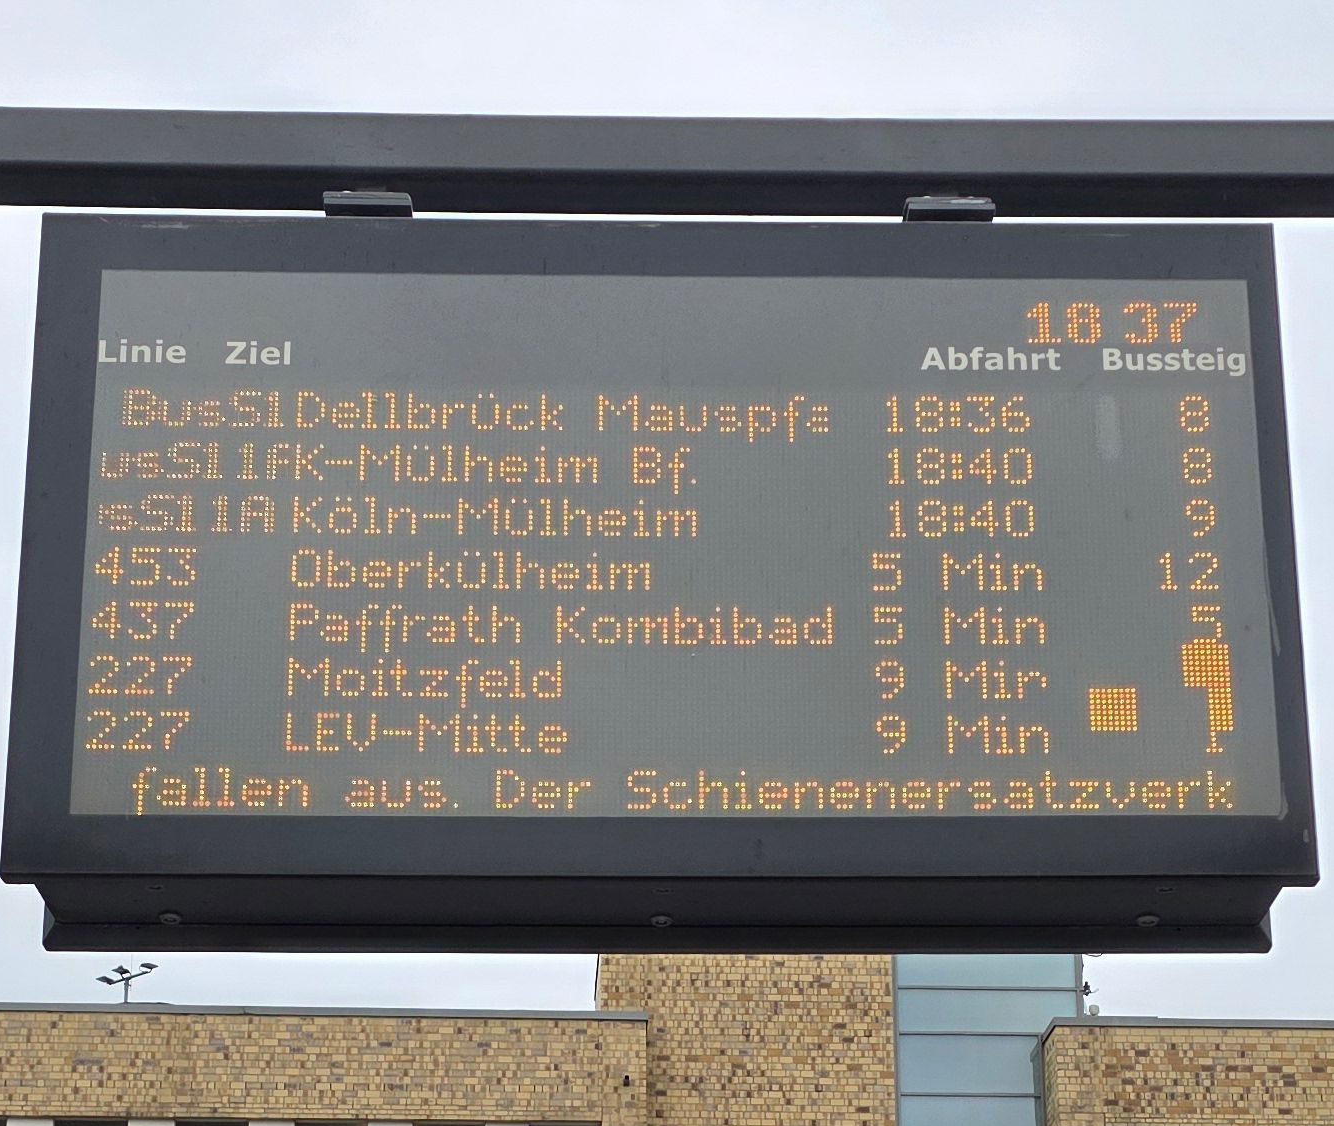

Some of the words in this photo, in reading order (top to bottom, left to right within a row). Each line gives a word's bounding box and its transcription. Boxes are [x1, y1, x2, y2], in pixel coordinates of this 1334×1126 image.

[1025, 302, 1101, 344] 18
[1123, 302, 1198, 344] 37
[98, 340, 187, 363] Linie
[225, 341, 292, 365] Ziel
[921, 347, 1061, 371] Abfahrt
[1102, 347, 1247, 377] Bussteig
[886, 396, 1031, 433] 18:36
[1179, 396, 1210, 432] 8
[633, 445, 696, 494] Bf.
[887, 448, 1034, 485] 18:40
[1183, 448, 1213, 484] 8
[293, 496, 697, 537] Köln-Mülheim
[889, 500, 1035, 537] 18:40
[1185, 500, 1216, 537] 9
[95, 547, 197, 586] 453
[291, 549, 651, 591] Oberkülheim
[872, 553, 903, 591] 5
[942, 553, 1043, 591] Min
[1160, 552, 1219, 591] 12
[91, 601, 194, 640] 437
[289, 603, 521, 653] Paffrath
[556, 605, 833, 645] Kombibad
[874, 607, 903, 645] 5
[944, 607, 1046, 645] Min
[87, 656, 193, 695] 227
[288, 658, 563, 709] Moitzfeld
[876, 660, 906, 699] 9
[85, 711, 191, 751] 227
[286, 712, 568, 753] LEV-Mitte
[876, 715, 907, 754] 9
[948, 715, 1050, 754] Min
[133, 767, 309, 816] fallen
[344, 779, 459, 809] aus.
[496, 769, 591, 809] Der
[627, 769, 1234, 811] Schienenersatzverk
